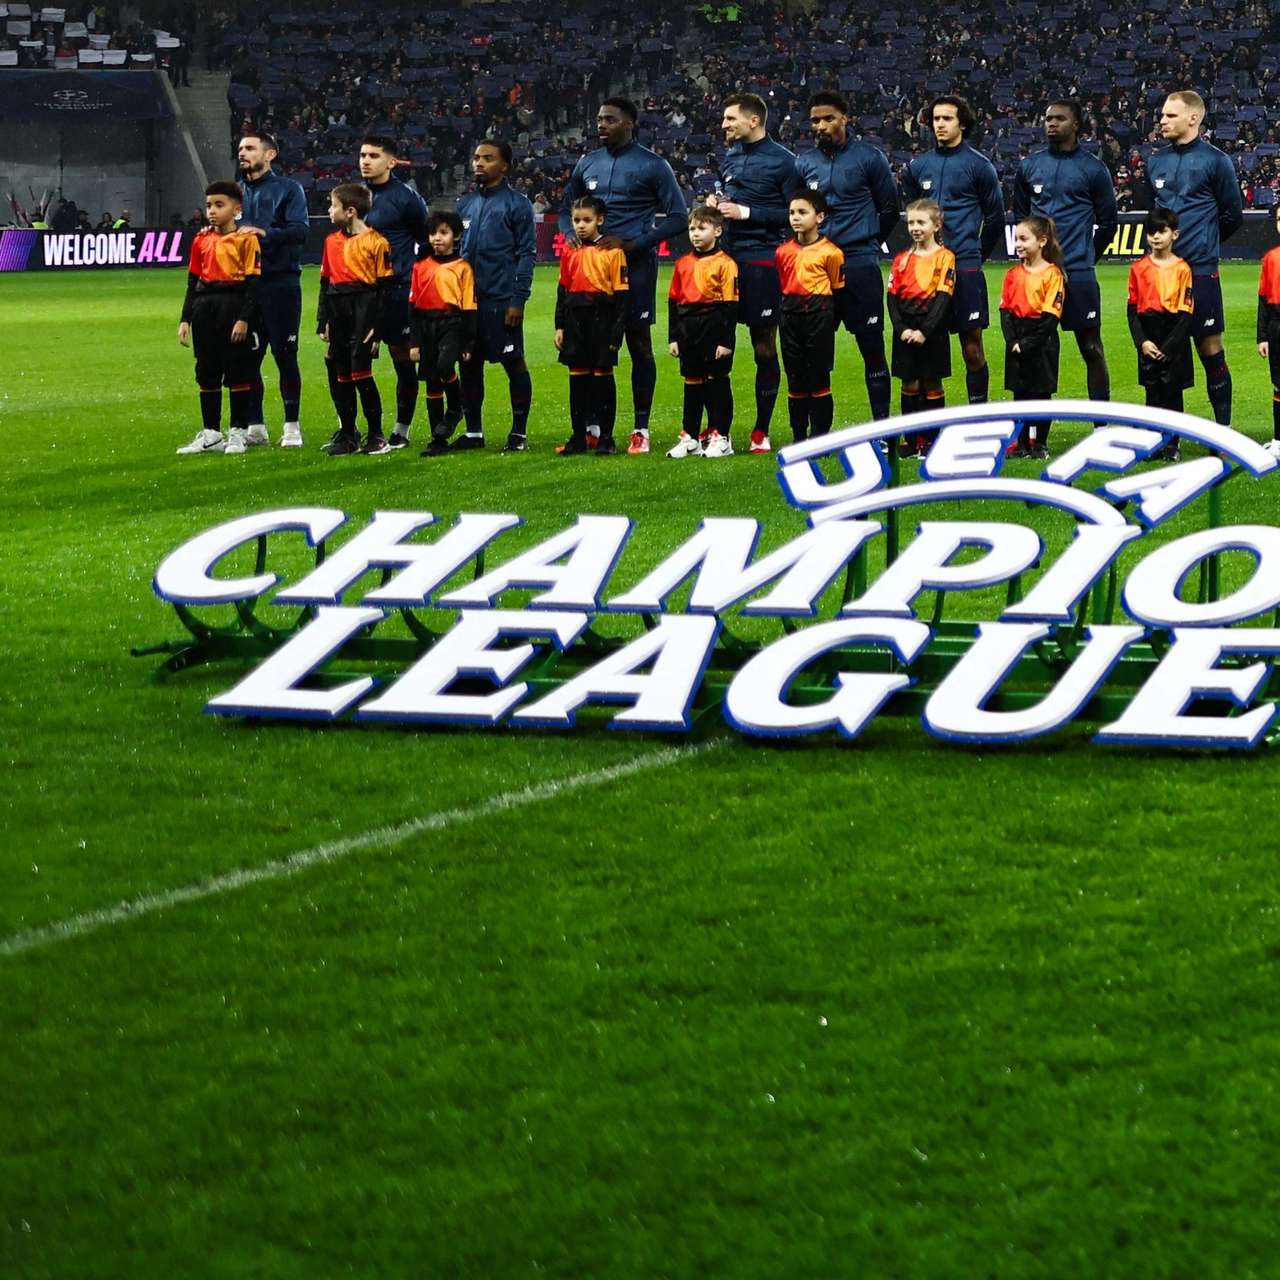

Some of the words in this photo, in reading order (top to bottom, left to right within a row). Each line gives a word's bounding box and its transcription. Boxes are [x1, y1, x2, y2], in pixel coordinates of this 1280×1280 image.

[43, 232, 137, 266] WELCOME
[137, 231, 184, 263] ALL
[1103, 223, 1145, 255] ALL
[776, 419, 1232, 528] UEFA
